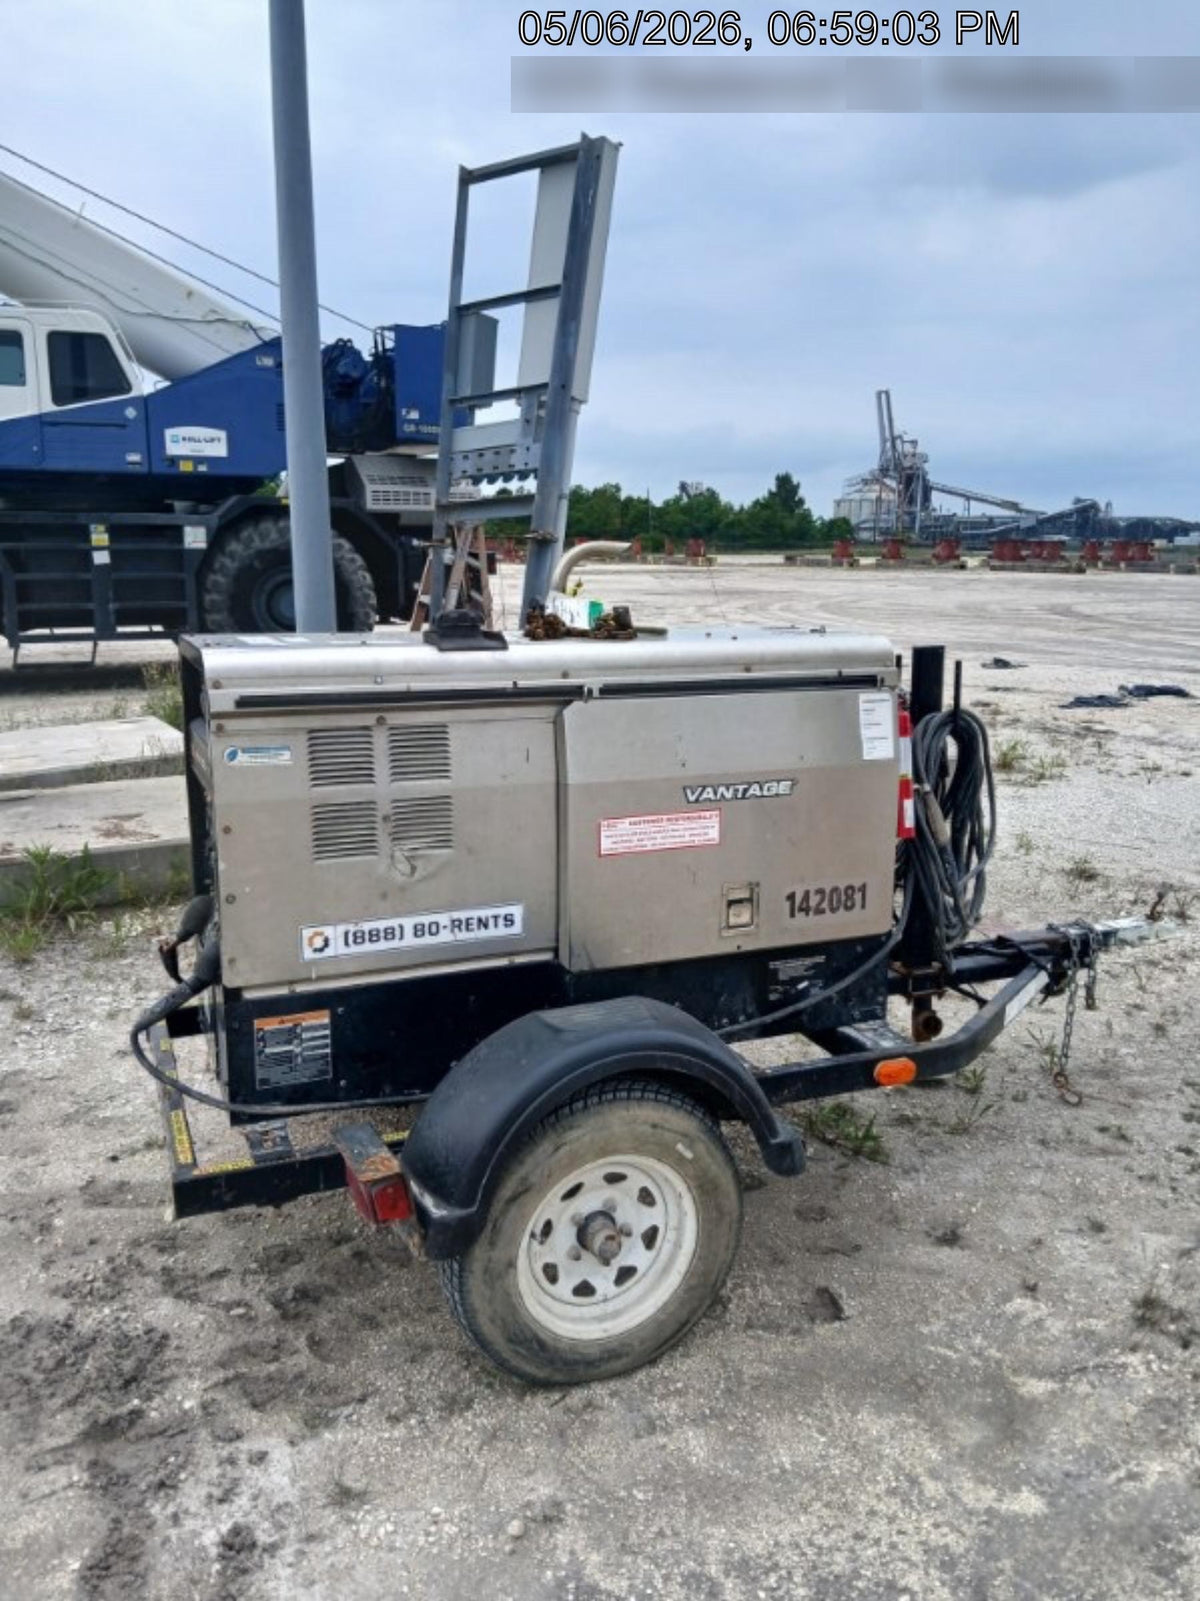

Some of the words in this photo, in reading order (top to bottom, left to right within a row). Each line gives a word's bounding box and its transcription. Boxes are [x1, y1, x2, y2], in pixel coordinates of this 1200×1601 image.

[684, 780, 796, 803] VANTAGE
[784, 882, 868, 918] 142081
[343, 923, 405, 948] (888)
[413, 912, 516, 939] 80-RENTS
